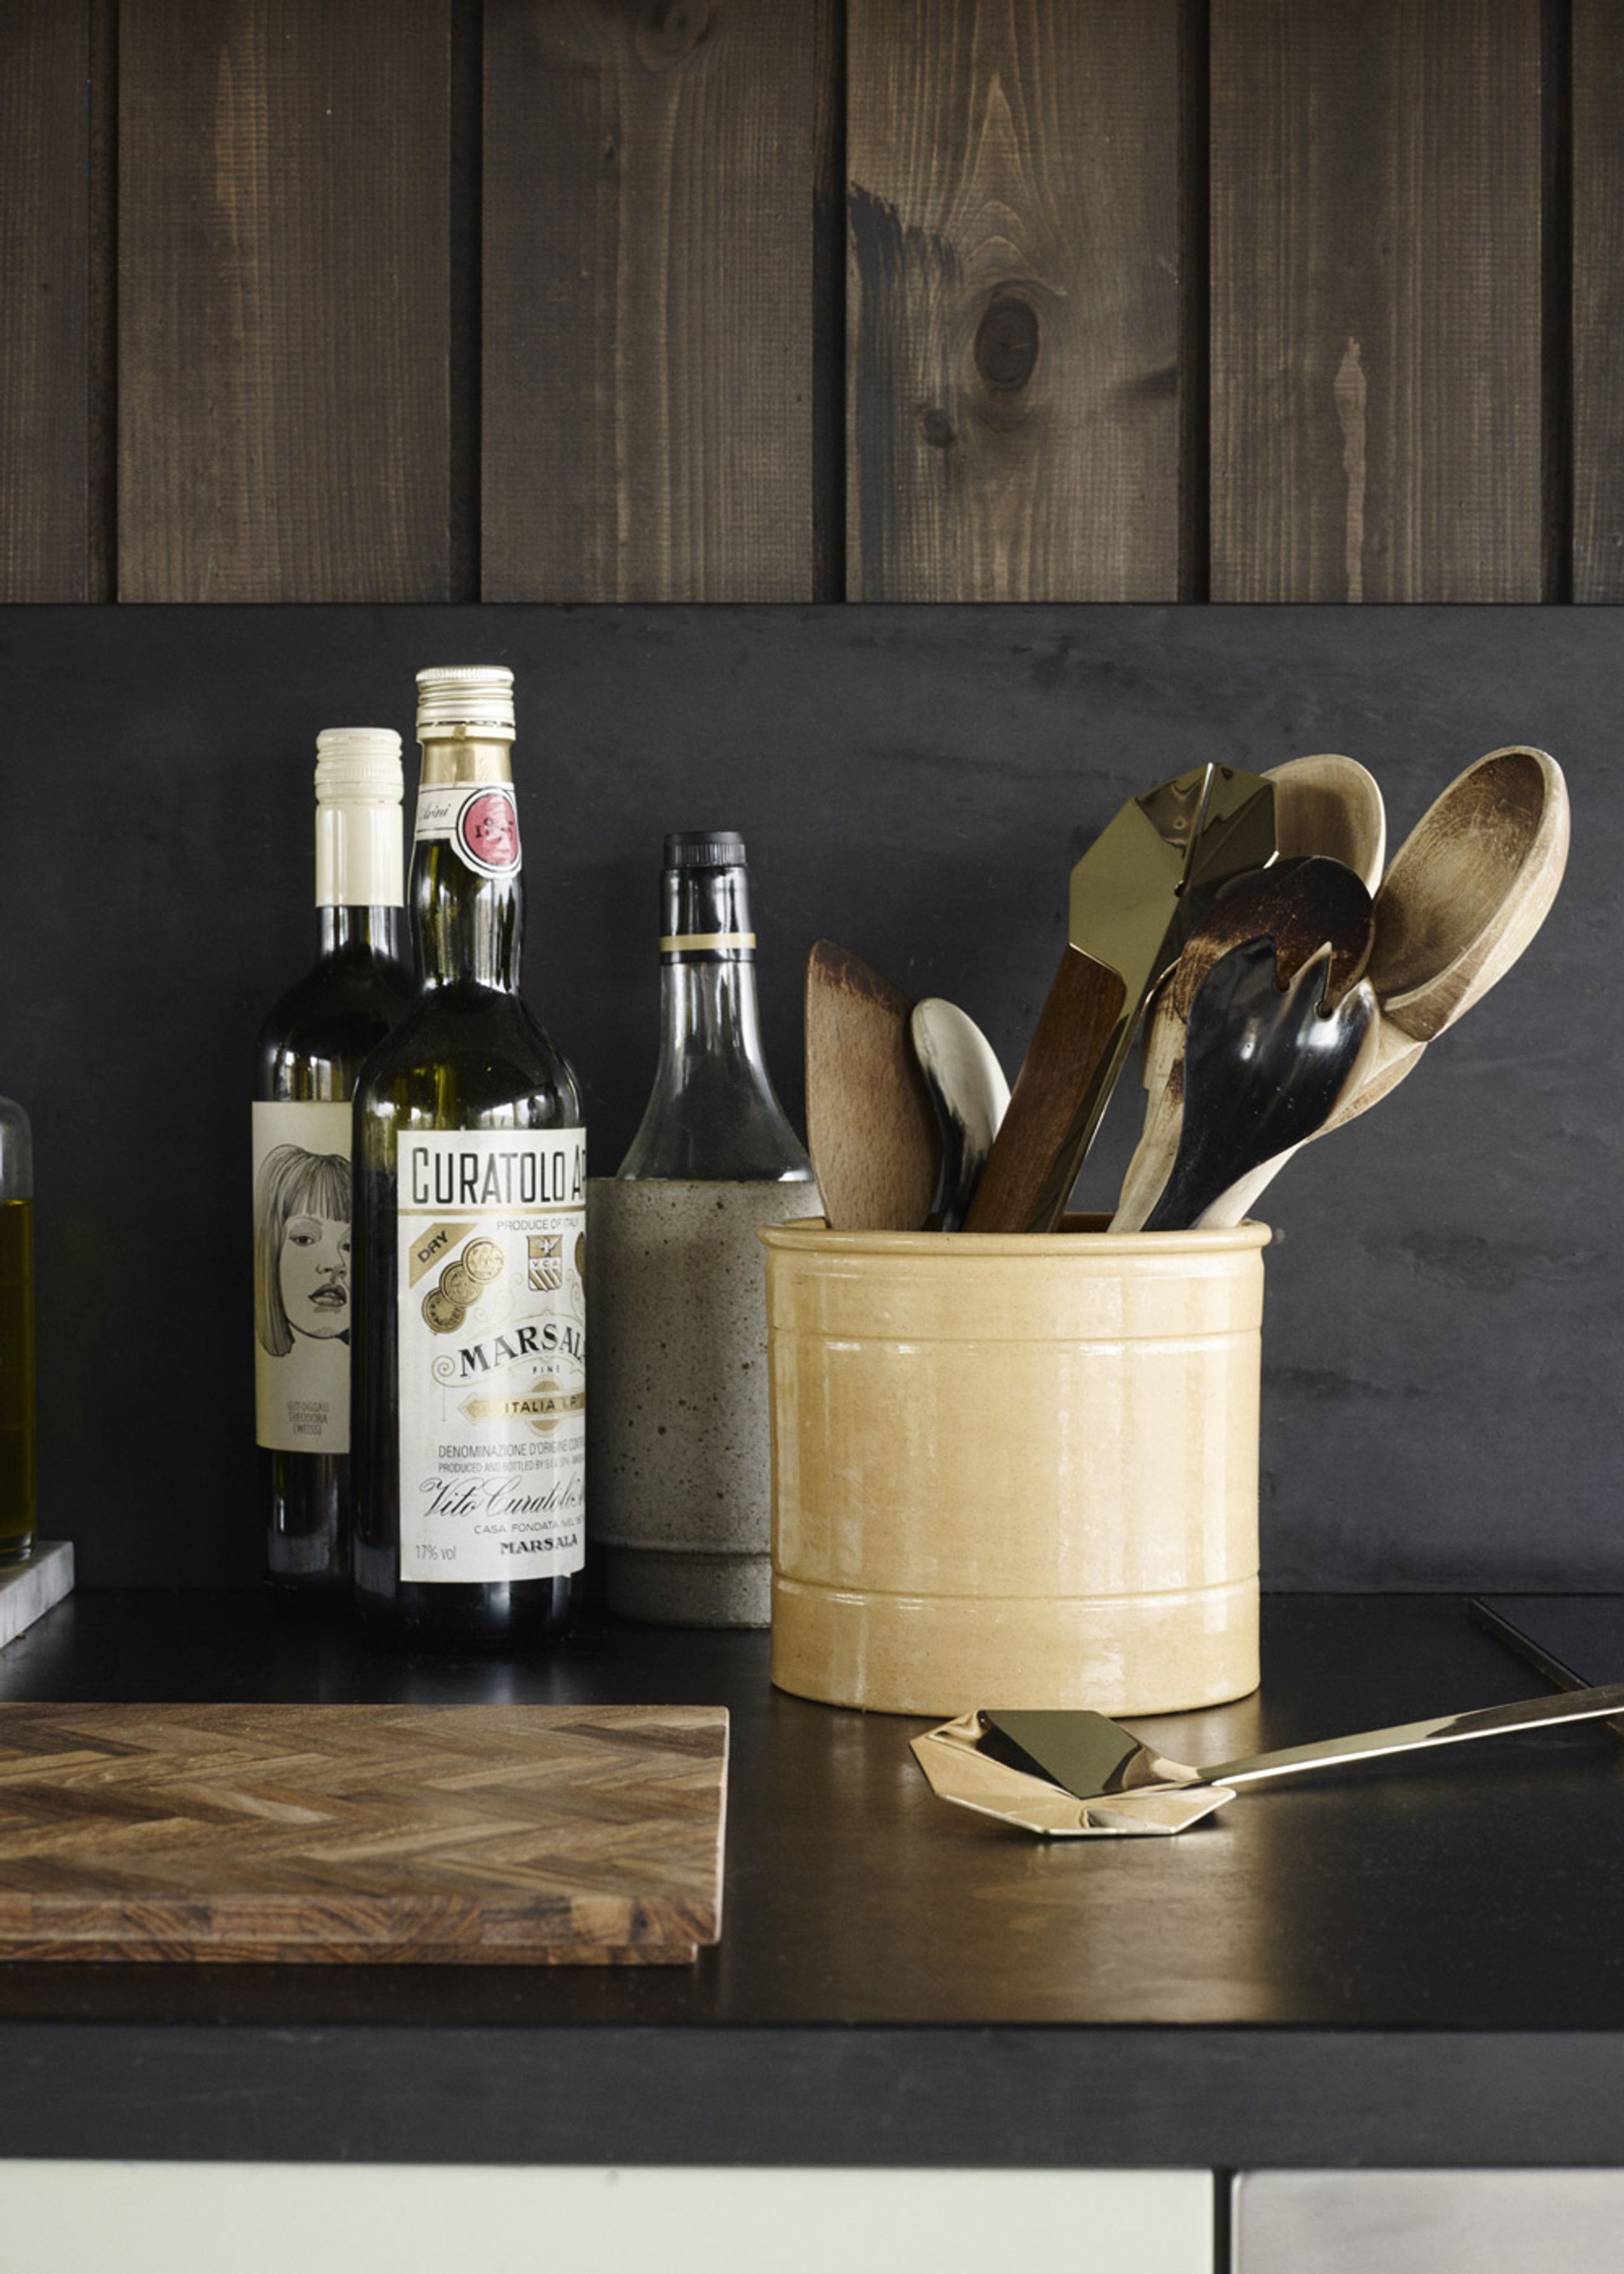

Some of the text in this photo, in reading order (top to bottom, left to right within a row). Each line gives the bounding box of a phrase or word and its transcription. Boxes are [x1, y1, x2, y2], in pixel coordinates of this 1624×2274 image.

[412, 1147, 565, 1204] CURATOLO
[497, 1219, 548, 1231] PRODUCE
[550, 1218, 561, 1229] OF
[417, 1230, 448, 1263] DRY
[505, 1398, 556, 1413] ITALIA
[438, 1442, 527, 1458] DENOMINAZIONE
[438, 1462, 482, 1473] PRODUCED
[485, 1461, 500, 1472] AND
[419, 1476, 484, 1518] Vito
[474, 1524, 507, 1535] CASA
[511, 1521, 559, 1534] FONDATA
[416, 1544, 457, 1560] 17% vol
[500, 1534, 577, 1555] MARSALA
